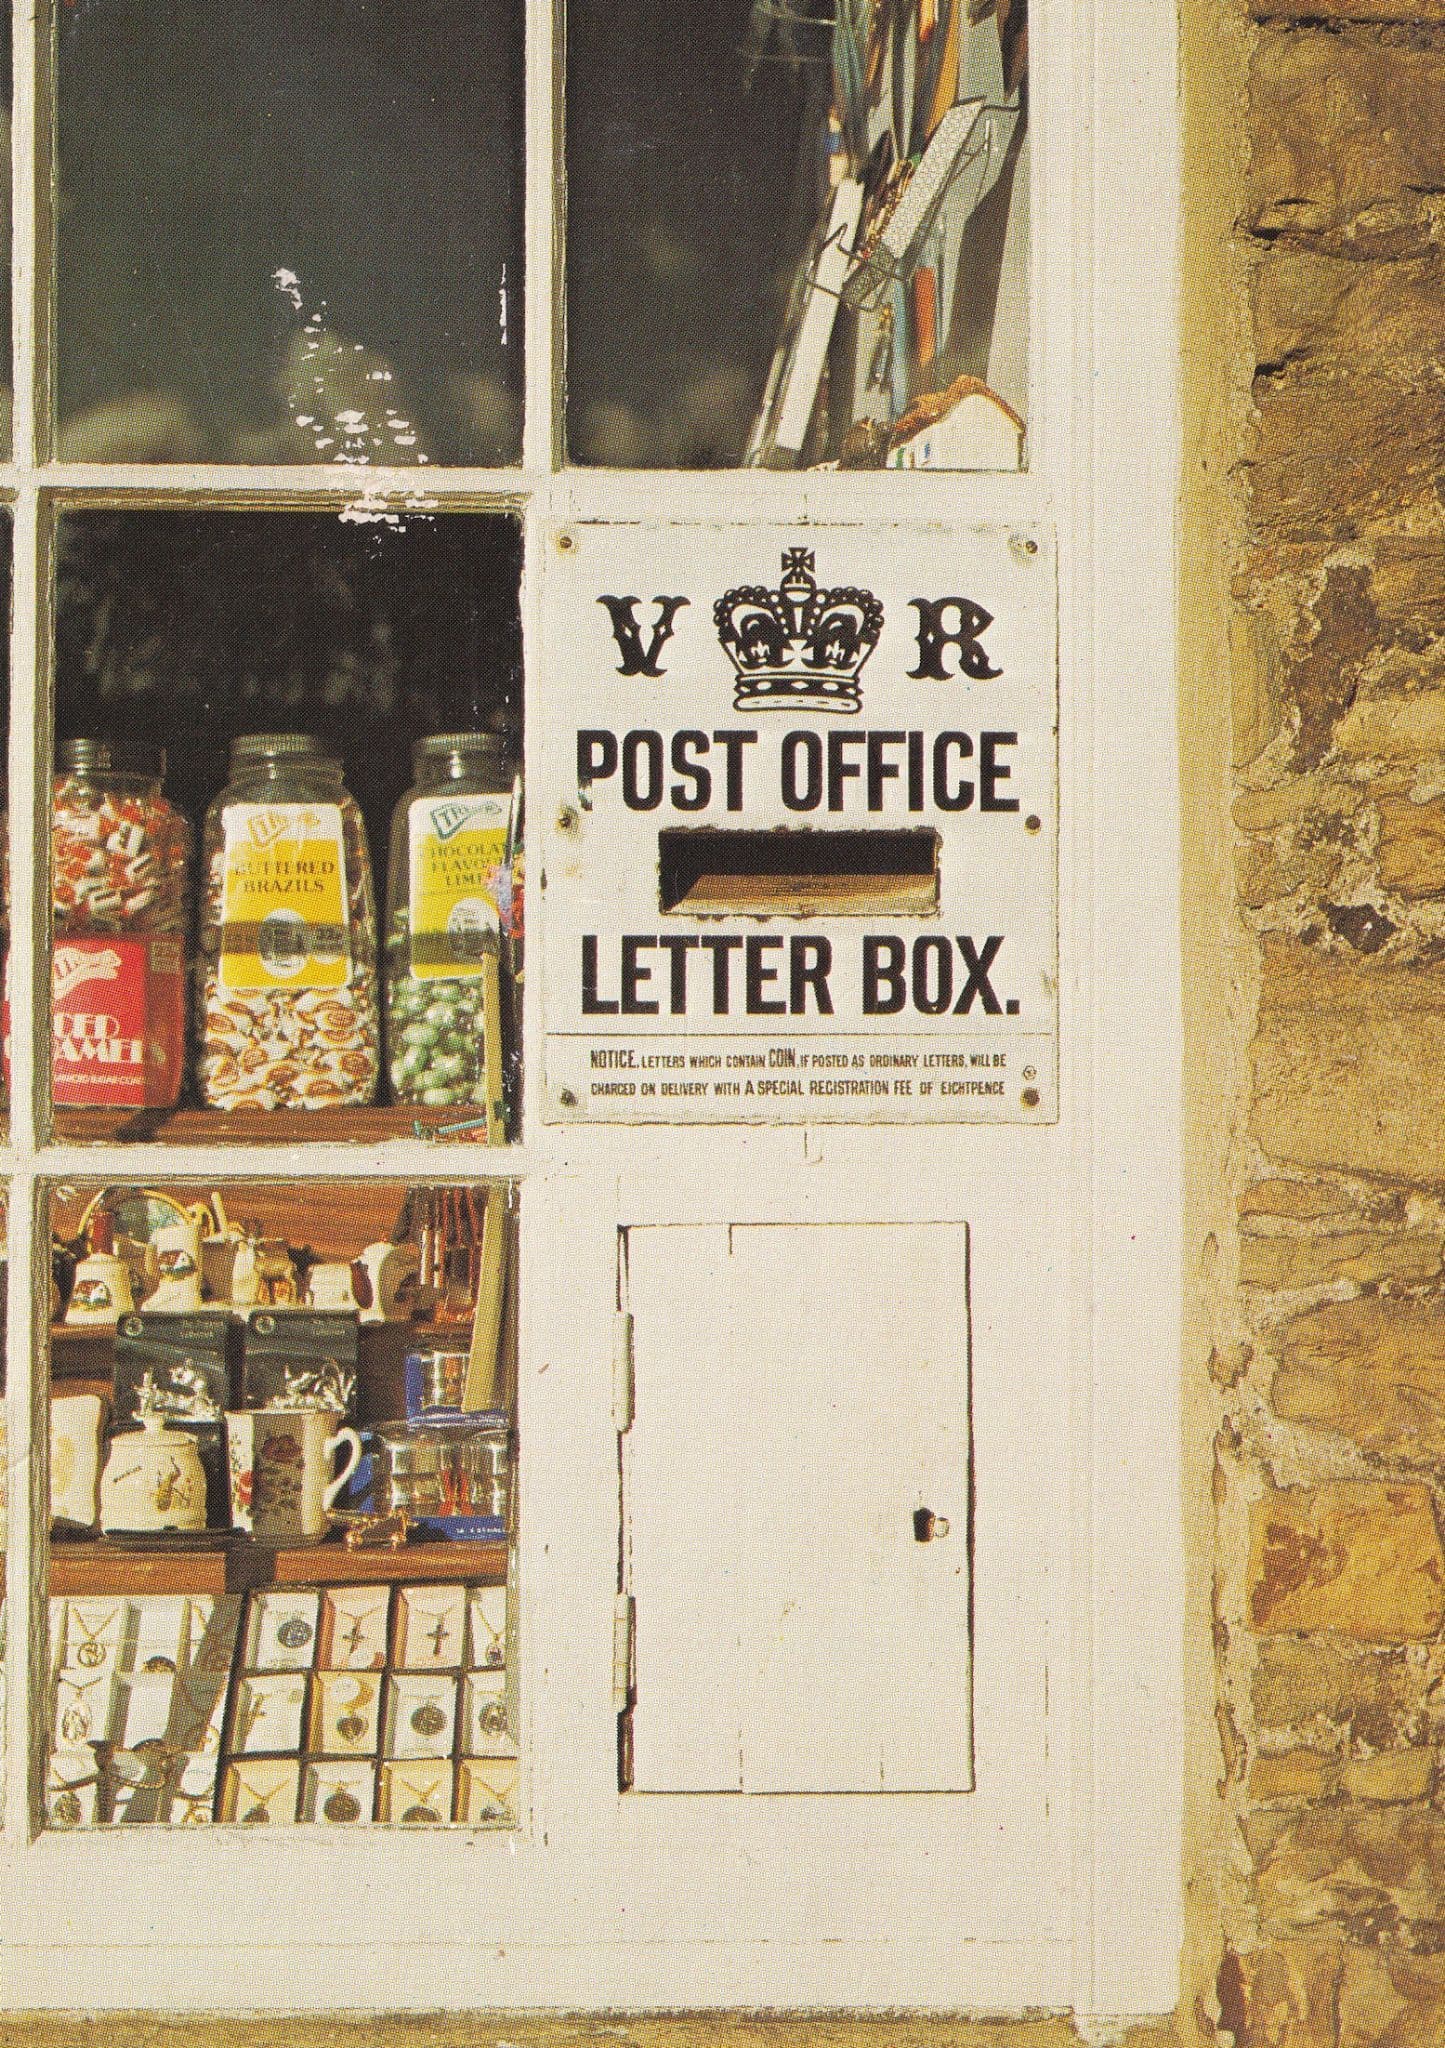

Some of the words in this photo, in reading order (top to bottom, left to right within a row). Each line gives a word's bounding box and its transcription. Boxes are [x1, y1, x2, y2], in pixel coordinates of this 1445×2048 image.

[597, 596, 689, 678] V
[907, 598, 1002, 680] R
[577, 730, 757, 812] POST
[782, 730, 1019, 812] OFFICE
[244, 879, 325, 893] BRAZILS
[583, 935, 833, 1015] LETTER
[863, 935, 1020, 1015] BOX.
[590, 1050, 640, 1069] NOTICE.
[641, 1055, 685, 1069] LETTERS
[689, 1055, 722, 1068] WHICH
[726, 1055, 766, 1068] CONTAIN
[800, 1054, 810, 1067] IF
[812, 1054, 849, 1068] POSTED
[851, 1054, 866, 1068] AS
[869, 1054, 919, 1068] ORDINARY
[970, 1054, 991, 1067] WILL
[992, 1053, 1007, 1067] BE
[641, 1082, 656, 1096] ON
[661, 1082, 709, 1096] DELIVERY
[714, 1082, 741, 1095] WITH
[744, 1080, 755, 1095] A
[757, 1080, 805, 1096] SPECIAL
[809, 1080, 889, 1096] REGISTRATION
[894, 1080, 912, 1096] FEE
[919, 1081, 934, 1095] OF
